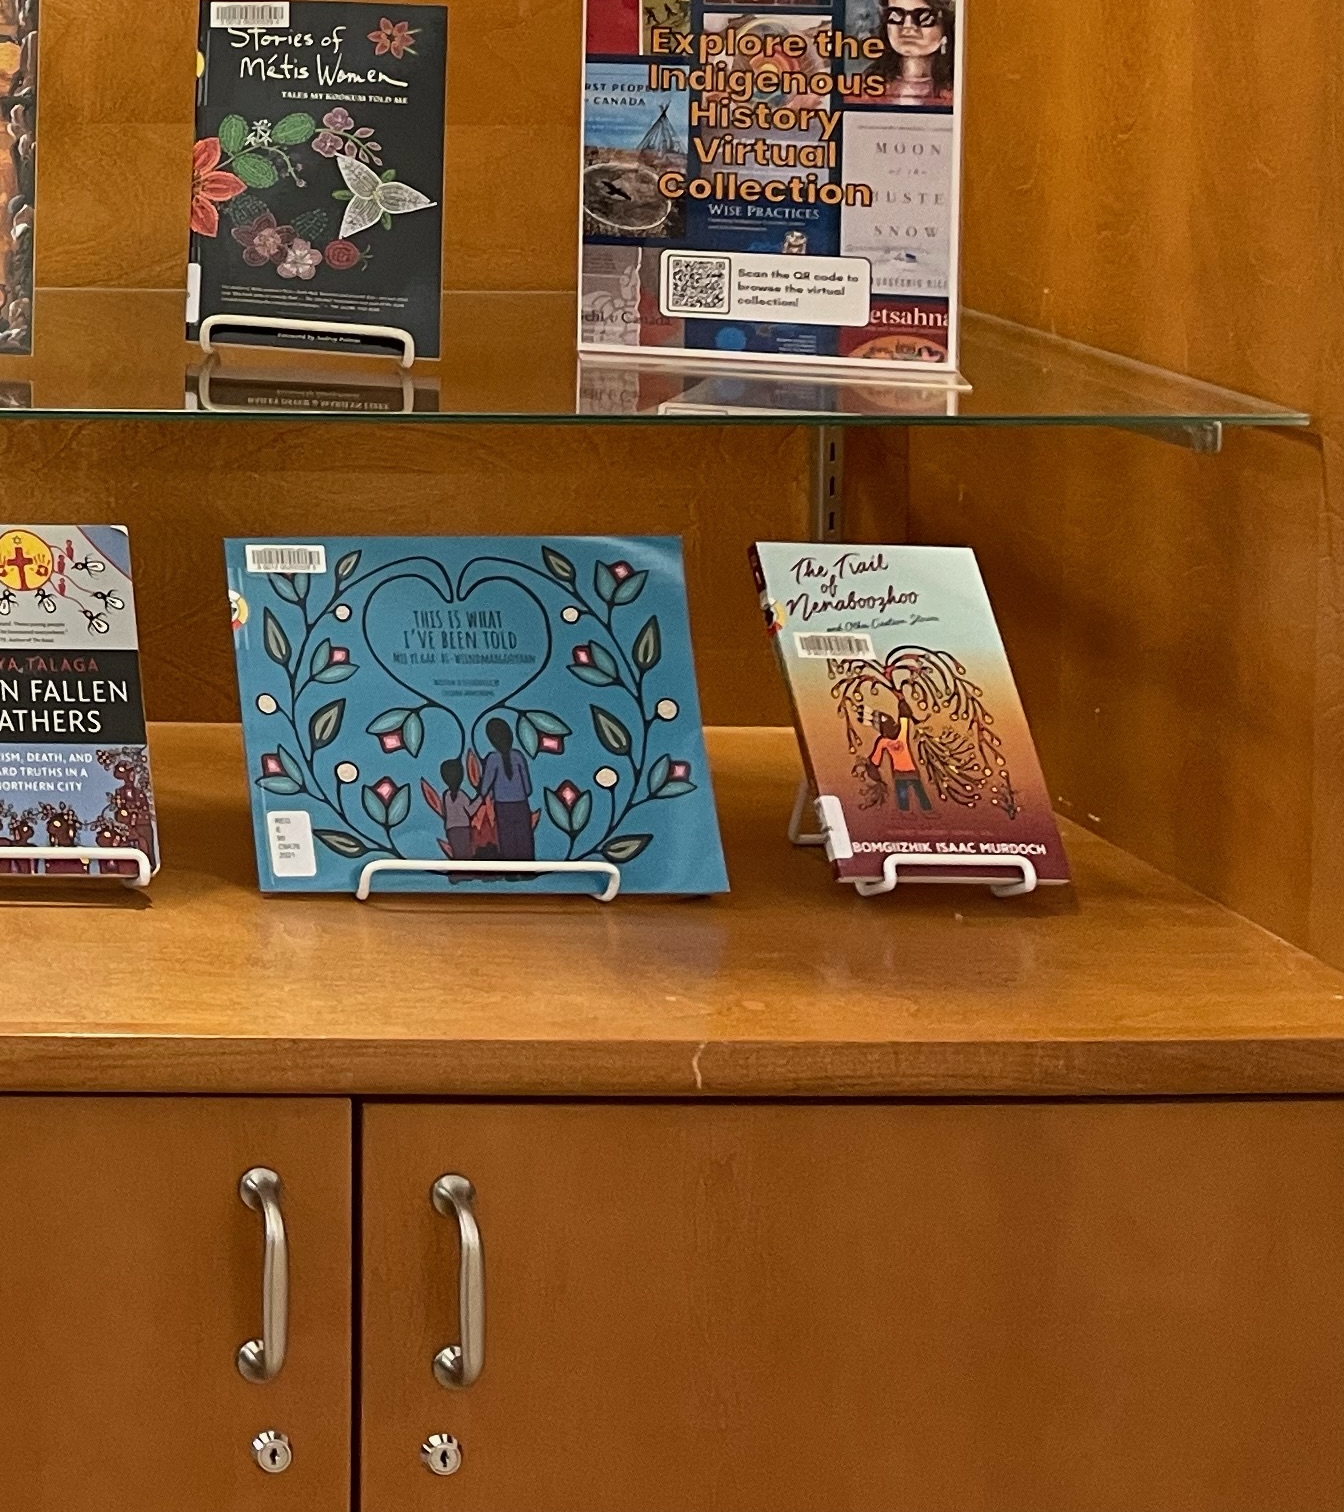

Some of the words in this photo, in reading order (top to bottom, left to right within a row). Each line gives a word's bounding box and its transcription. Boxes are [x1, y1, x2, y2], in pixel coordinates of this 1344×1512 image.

[228, 27, 314, 50] Stories
[321, 26, 347, 54] of
[650, 26, 812, 62] Explore
[815, 30, 886, 59] the
[240, 56, 310, 81] Métis
[317, 53, 408, 88] Women
[648, 63, 886, 99] Indigenous
[689, 101, 842, 140] History
[692, 136, 838, 169] Virtual
[875, 141, 942, 157] MOON
[657, 172, 874, 209] Collection
[874, 225, 938, 238] SNOW
[790, 557, 829, 584] The
[833, 552, 888, 579] Trail
[820, 574, 838, 597] of
[786, 585, 919, 621] Nenaboozhoo
[413, 610, 443, 628] THIS
[448, 610, 461, 628] IS
[466, 611, 502, 628] WHAT
[403, 629, 436, 649] I'VE
[441, 631, 477, 649] BEEN
[483, 631, 517, 650] TOLD
[26, 656, 99, 672] TALAGA
[30, 679, 128, 703] FALLEN
[27, 753, 66, 764] DEATH,
[69, 753, 93, 764] AND
[19, 767, 62, 777] TRUTHS
[65, 767, 78, 777] IN
[79, 767, 88, 778] A
[57, 781, 82, 792] CITY
[936, 842, 976, 853] ISAAC
[979, 842, 1046, 855] MURDOCH
